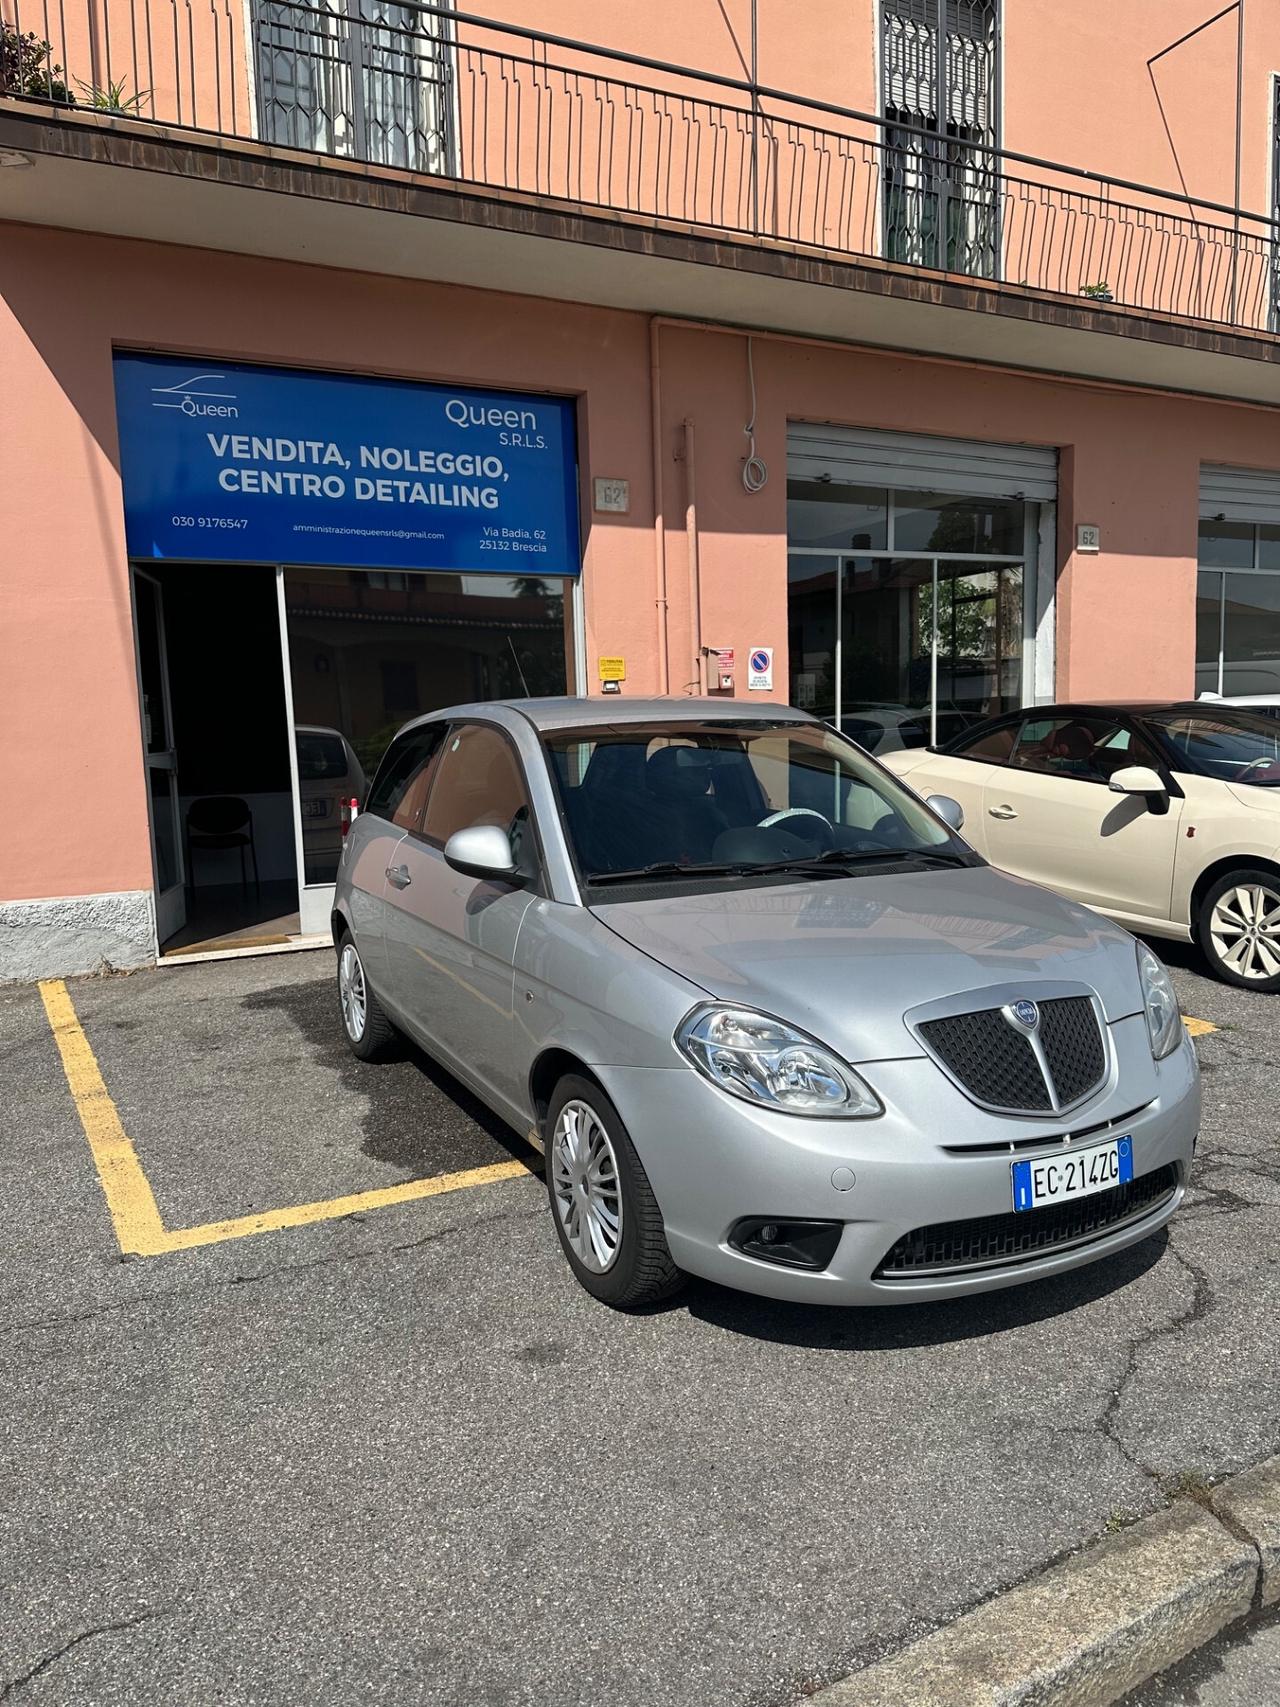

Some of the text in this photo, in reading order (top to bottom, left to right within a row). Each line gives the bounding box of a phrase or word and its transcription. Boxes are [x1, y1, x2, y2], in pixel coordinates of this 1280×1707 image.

[181, 400, 239, 418] Queen
[445, 399, 537, 430] Queen
[499, 432, 548, 449] S.R.L.S.
[206, 433, 510, 482] VENDITA, NOLEGGIO,
[218, 468, 500, 509] CENTRO DETAILING
[172, 516, 248, 529] 030 9176547
[293, 524, 445, 540] amministrazionequeensrls@gmail.com
[483, 526, 547, 540] Via Badia, 62
[1082, 531, 1095, 545] 62
[479, 540, 547, 553] 25132 Brescia
[1034, 1150, 1119, 1198] EC 214ZG
